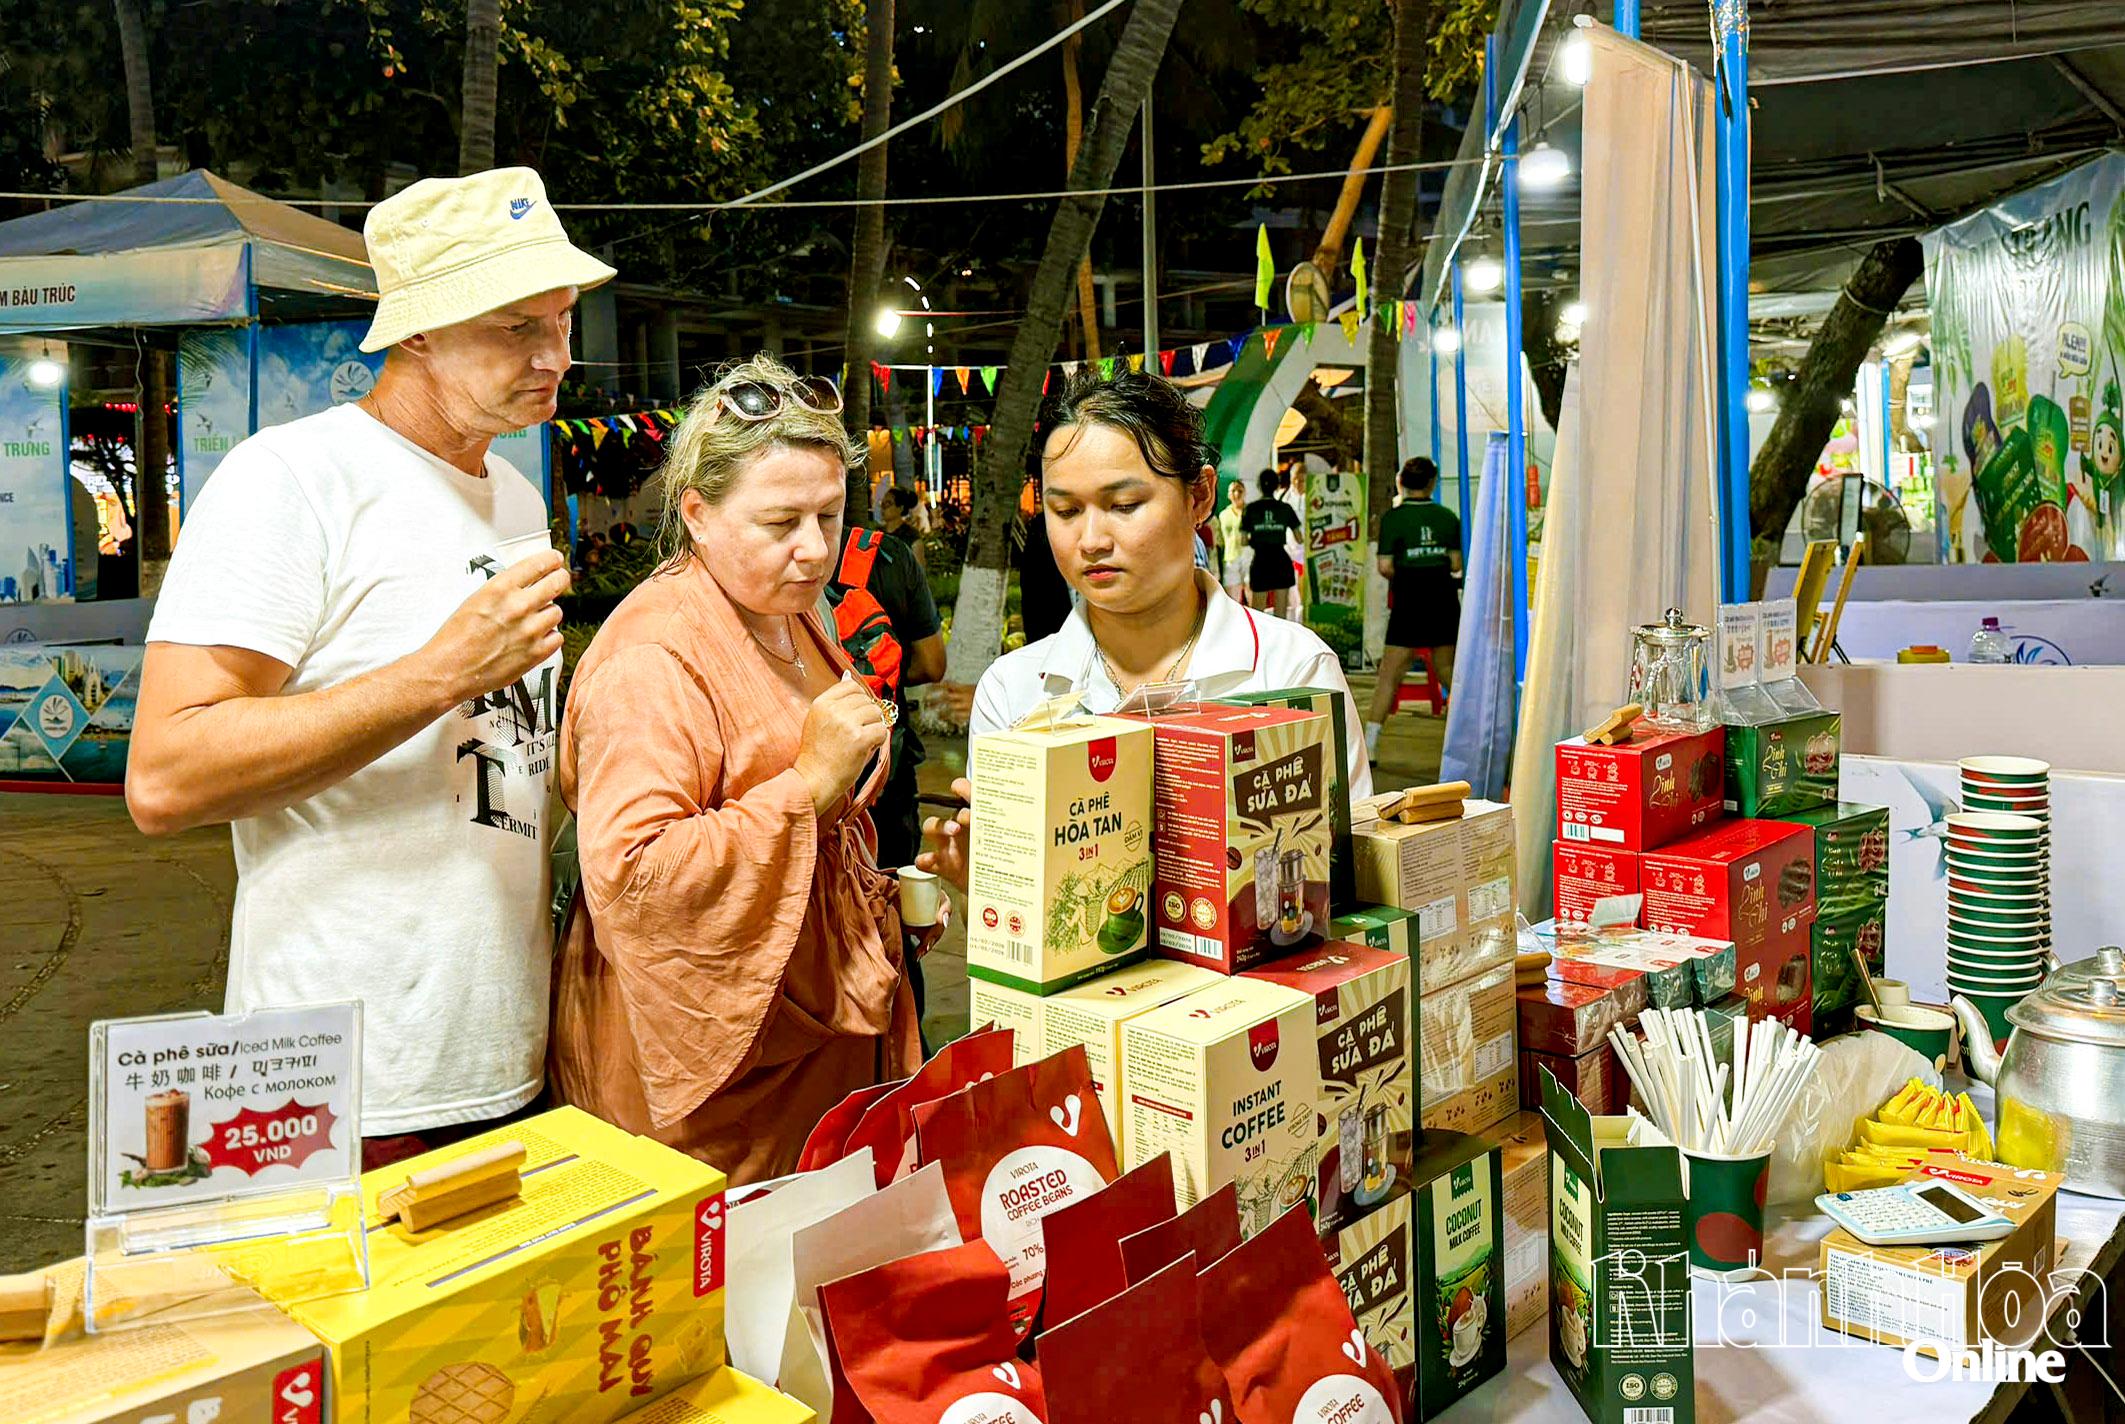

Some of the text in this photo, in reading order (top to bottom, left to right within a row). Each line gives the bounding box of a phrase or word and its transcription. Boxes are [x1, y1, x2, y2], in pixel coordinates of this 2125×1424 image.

[43, 283, 76, 303] TRÚC
[527, 740, 545, 756] IT'S
[1253, 756, 1303, 789] CÀ PHÊ
[1069, 792, 1110, 817] CÀ PHÊ
[1247, 773, 1312, 812] SỮA ĐÁ
[1054, 812, 1122, 847] HÒA TAN
[1337, 1005, 1387, 1048] CÀ PHÊ
[118, 1050, 147, 1067] Cà
[153, 1047, 190, 1065] phê
[272, 1036, 296, 1050] Milk
[299, 1033, 342, 1048] Coffee
[1332, 1021, 1396, 1075] SỮA ĐÁ
[204, 1074, 336, 1101] Кофе с молоком
[1233, 1080, 1282, 1117] INSTANT
[225, 1115, 318, 1150] 25.000
[1222, 1101, 1285, 1149] COFFEE
[253, 1145, 292, 1163] VND
[1010, 1162, 1039, 1180] VIROTA
[999, 1169, 1067, 1210] ROASTED
[1007, 1185, 1074, 1221] COFFEE BEANS
[1446, 1199, 1482, 1236] COCONUT
[1559, 1198, 1583, 1242] COCONUT
[1022, 1242, 1044, 1261] 70%
[1449, 1222, 1481, 1251] MILK COFFEE
[630, 1225, 658, 1329] BÁNH
[700, 1231, 713, 1289] VIROTA
[1361, 1244, 1389, 1280] PHÊ
[1371, 1258, 1398, 1298] ĐÁ
[598, 1240, 628, 1393] PHÔ MAI
[1328, 1393, 1365, 1424] COFFEE
